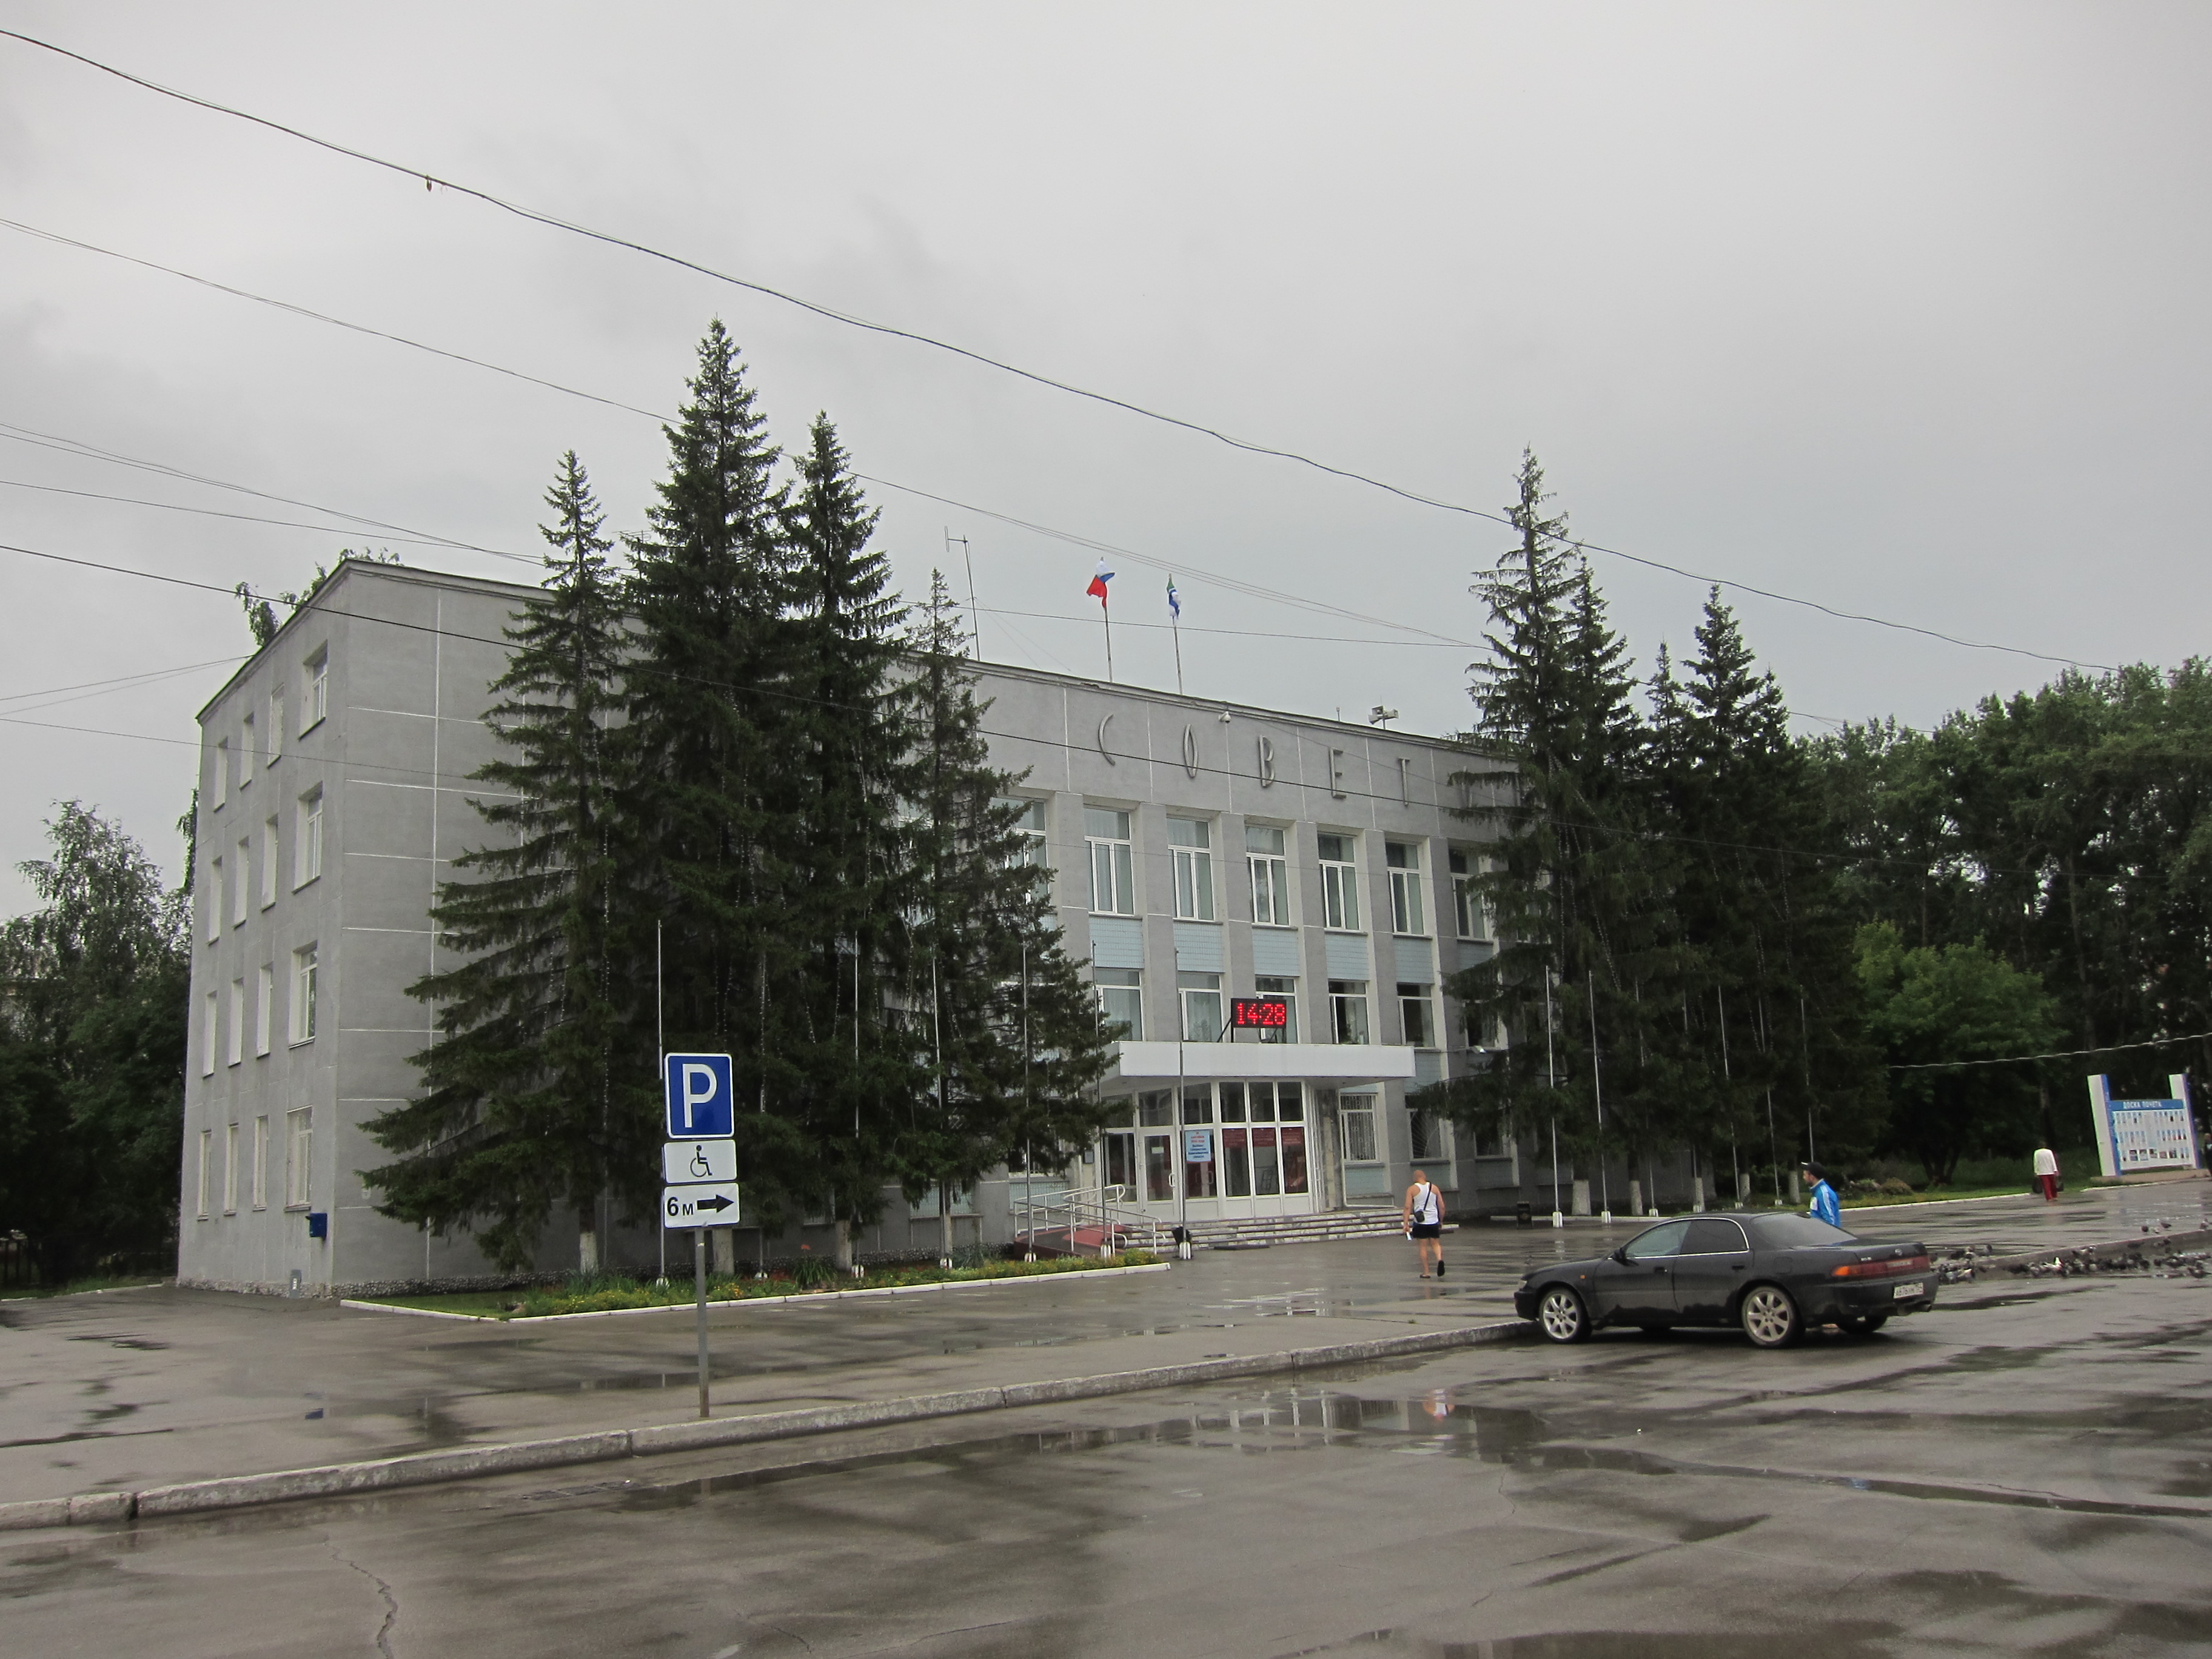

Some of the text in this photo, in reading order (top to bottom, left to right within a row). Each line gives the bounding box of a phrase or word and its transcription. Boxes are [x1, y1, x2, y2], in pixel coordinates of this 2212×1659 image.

[1098, 713, 1410, 806] СОВЕТ
[1237, 1003, 1285, 1025] 14:28
[682, 1064, 717, 1128] P
